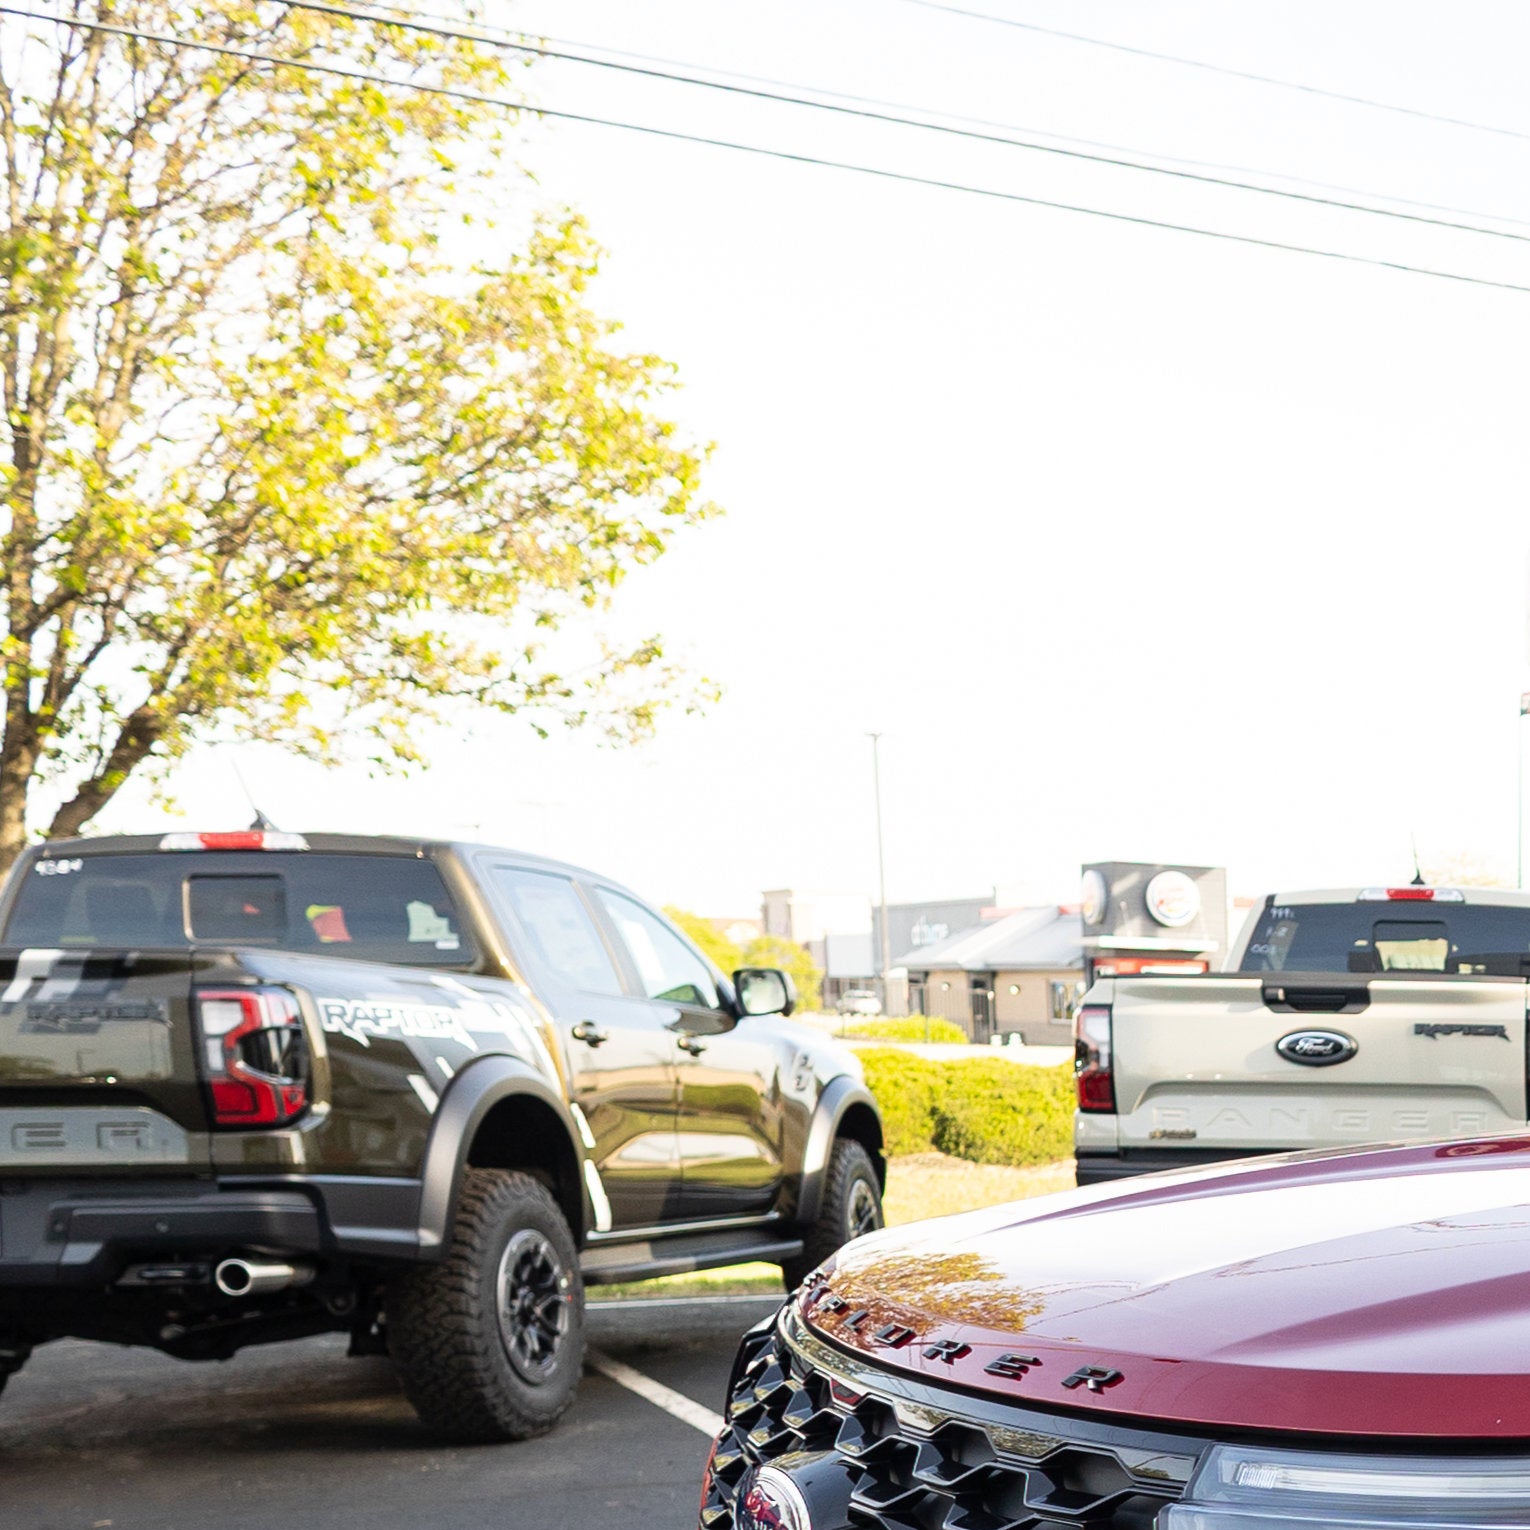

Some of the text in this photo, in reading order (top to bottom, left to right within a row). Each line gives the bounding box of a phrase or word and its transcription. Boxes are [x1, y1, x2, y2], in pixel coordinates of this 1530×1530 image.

[1413, 1022, 1512, 1042] RAPTOR
[1295, 1036, 1336, 1056] Ford
[1151, 1106, 1488, 1133] RANGER
